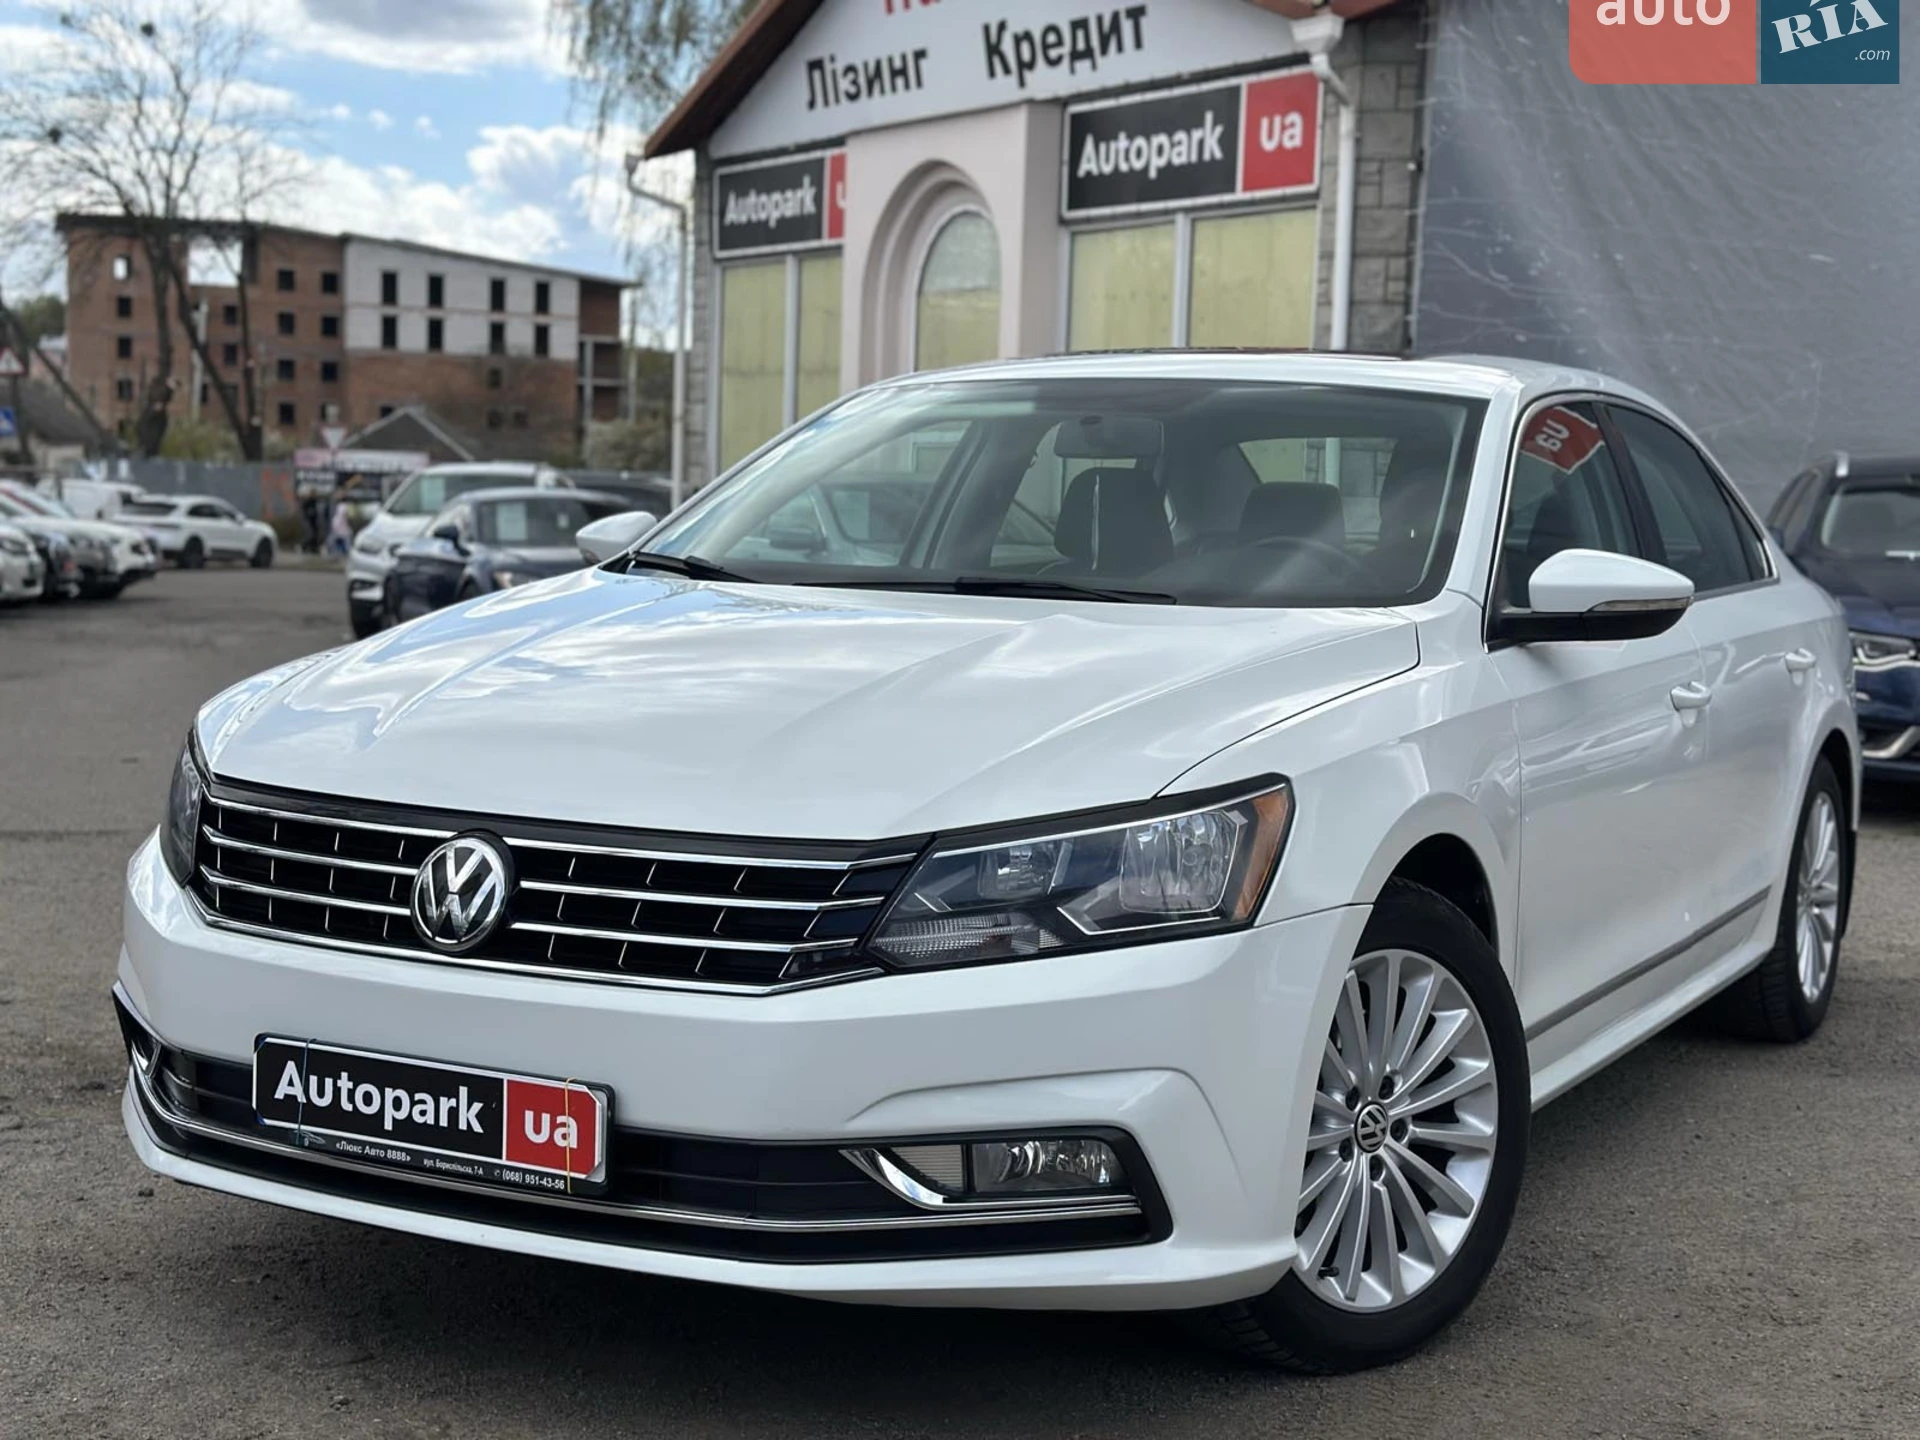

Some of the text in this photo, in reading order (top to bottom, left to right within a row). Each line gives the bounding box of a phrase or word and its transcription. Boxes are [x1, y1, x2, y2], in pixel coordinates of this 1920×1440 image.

[805, 4, 1147, 111] Лізинг Кредит
[1076, 110, 1304, 180] Autopark ua
[723, 172, 817, 229] Autopark
[274, 1060, 579, 1149] Autopark ua
[363, 1145, 385, 1158] Авто
[502, 1168, 565, 1190] (068) 951-43-56
